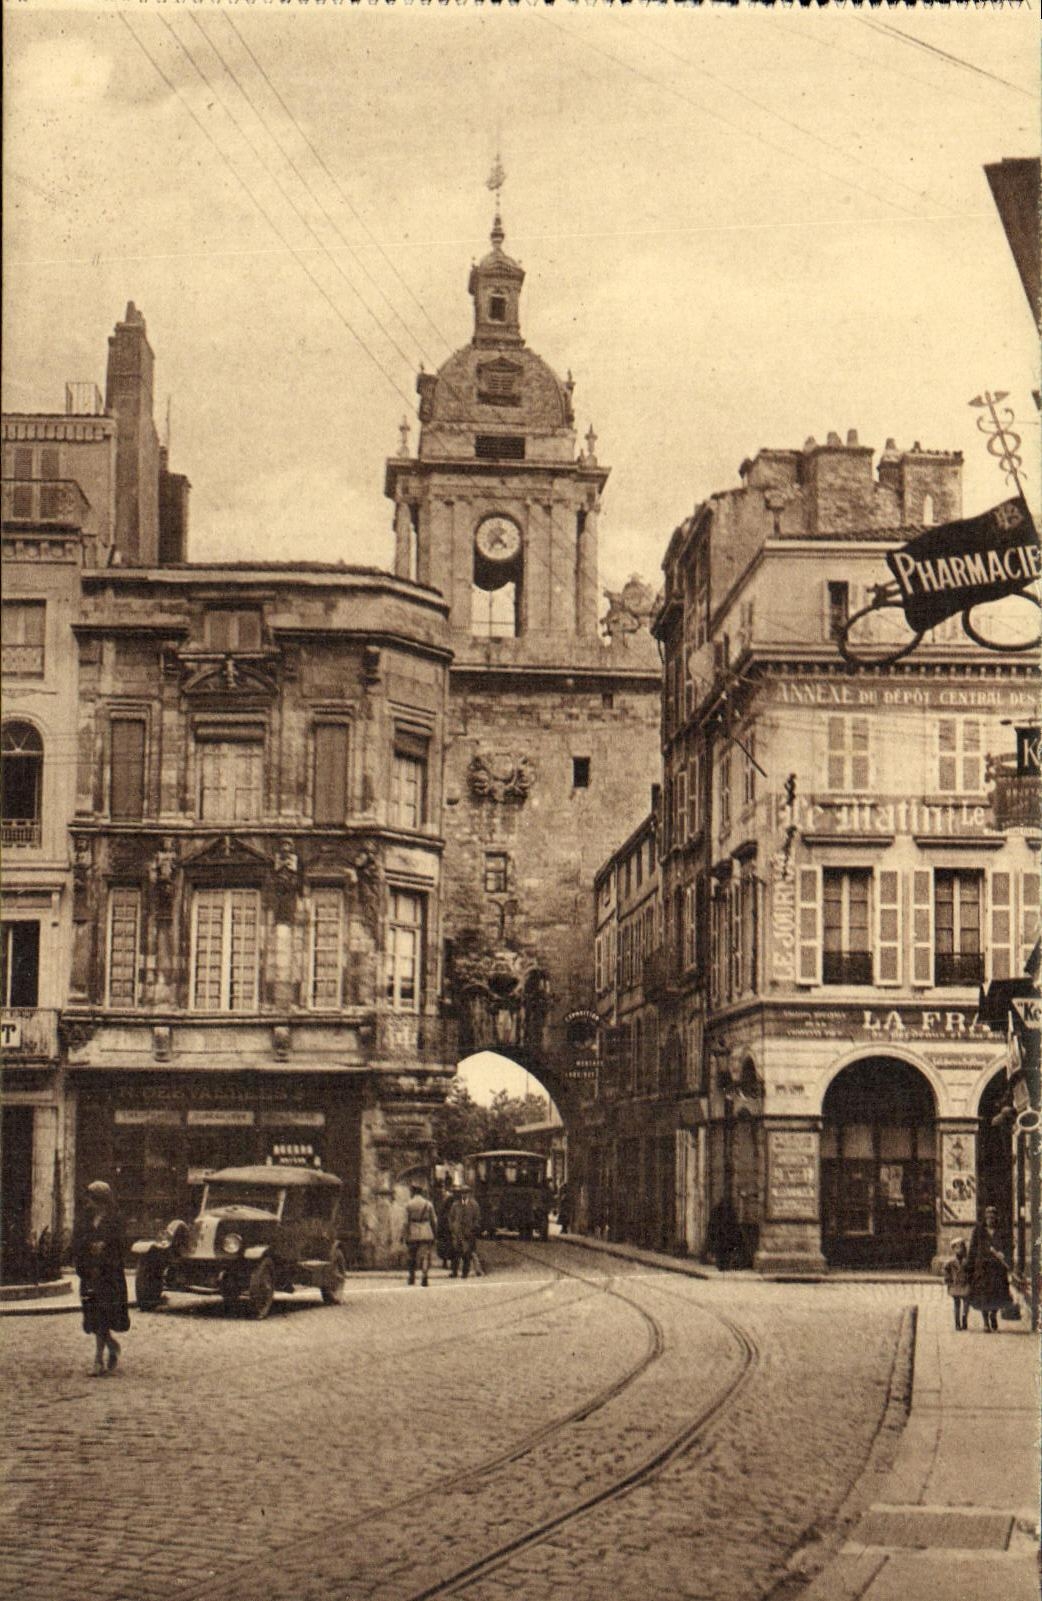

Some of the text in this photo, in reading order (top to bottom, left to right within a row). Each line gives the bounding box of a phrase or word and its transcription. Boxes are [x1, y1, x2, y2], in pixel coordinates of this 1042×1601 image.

[893, 545, 1041, 595] PHARMACIE
[776, 682, 853, 704] ANNEXE
[858, 689, 878, 704] DU
[939, 689, 1002, 705] CENTRAL
[773, 952, 794, 981] LE
[862, 1010, 906, 1029] LA
